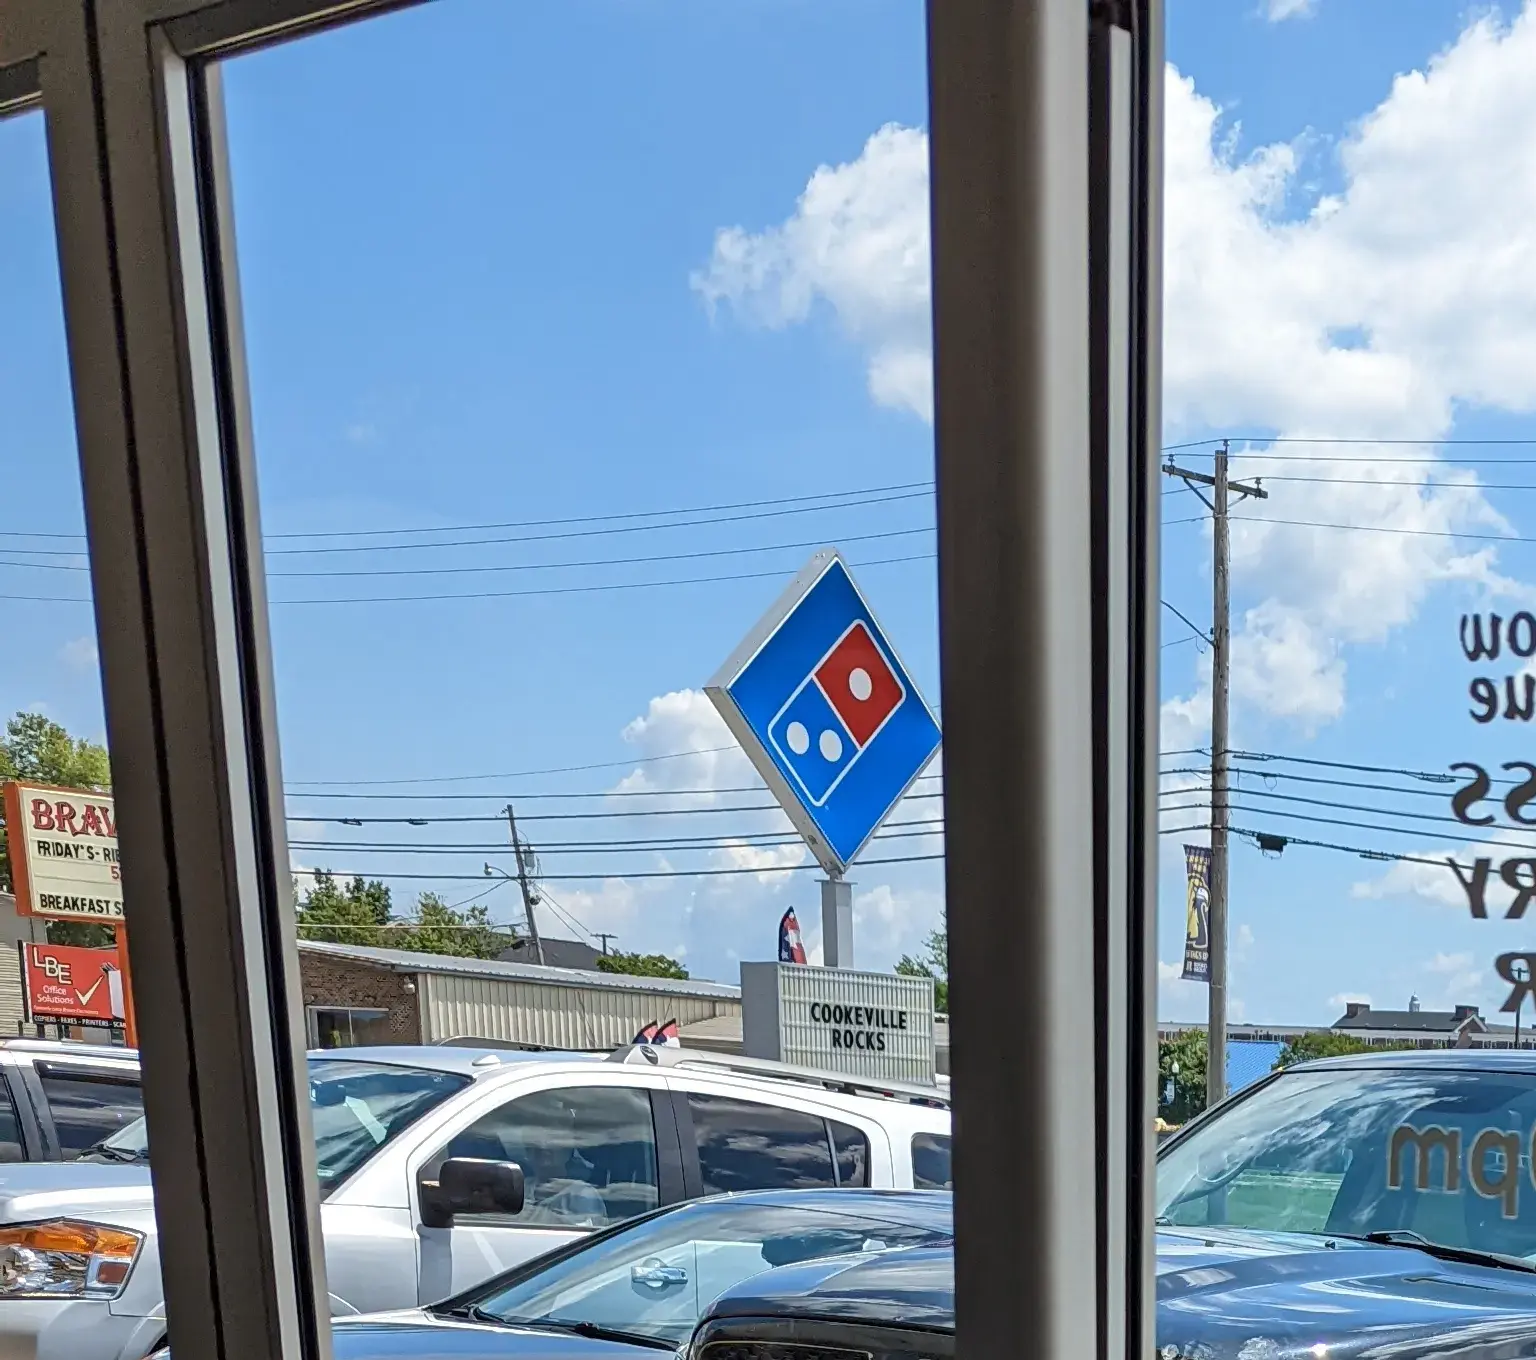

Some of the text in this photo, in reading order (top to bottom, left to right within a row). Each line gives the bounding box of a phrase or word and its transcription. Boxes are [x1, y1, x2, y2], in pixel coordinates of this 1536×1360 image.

[40, 894, 111, 915] BREAKFAST
[33, 946, 73, 985] LBE
[811, 1002, 907, 1029] COOKEVILLE
[832, 1029, 886, 1051] ROCKS
